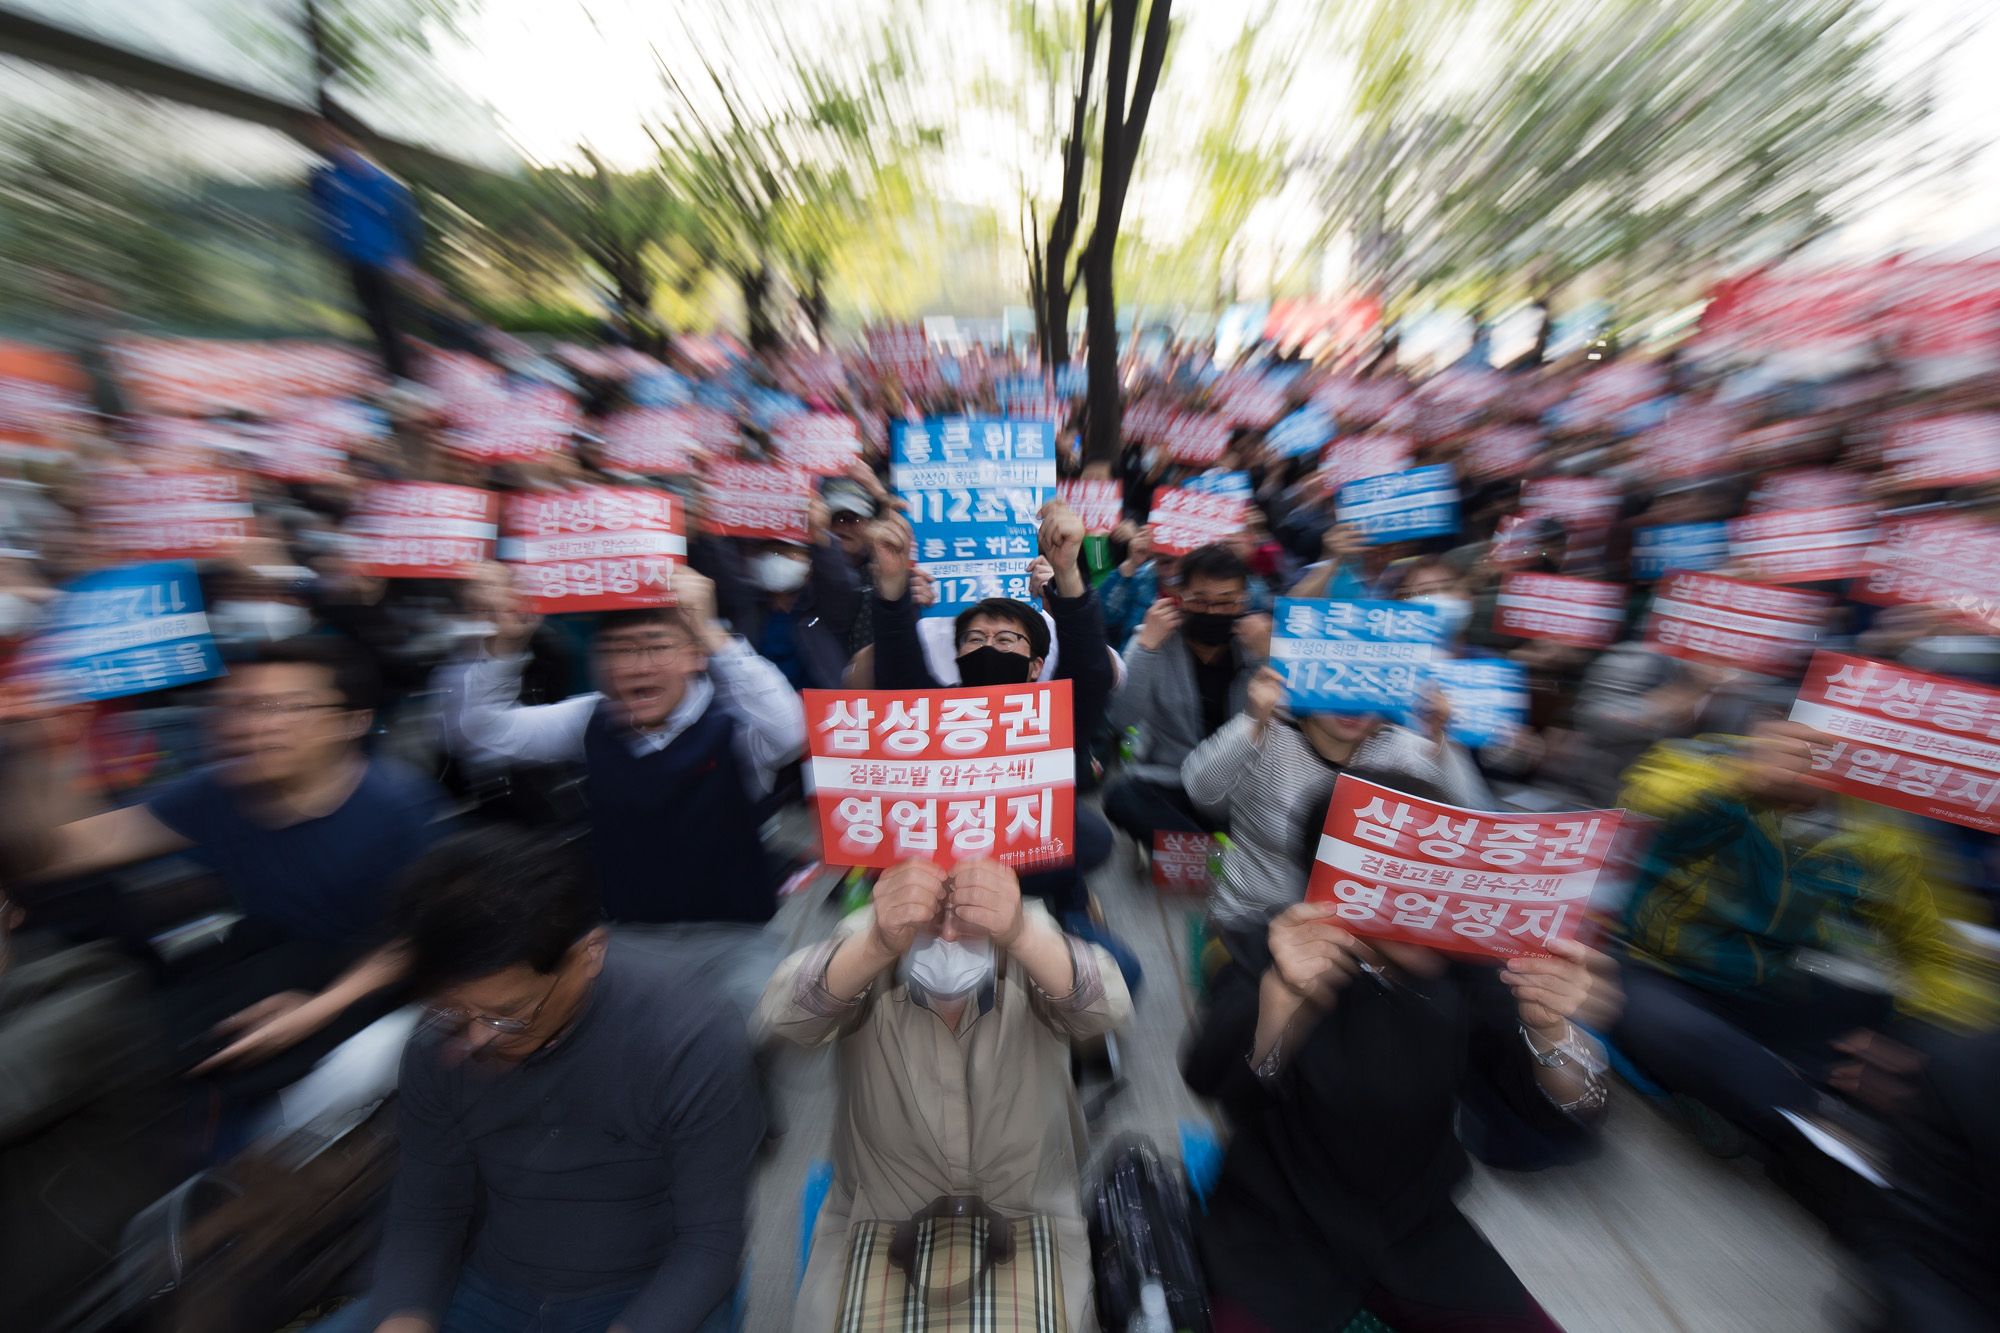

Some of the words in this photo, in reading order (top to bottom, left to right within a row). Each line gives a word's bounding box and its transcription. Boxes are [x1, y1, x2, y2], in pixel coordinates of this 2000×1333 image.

[984, 423, 1044, 461] 위조
[537, 557, 674, 597] 영업정지
[1285, 605, 1313, 633] 통
[1325, 602, 1353, 636] 큰
[1364, 607, 1425, 638] 위조
[1289, 641, 1327, 656] 삼성이
[1332, 643, 1358, 657] 하면
[1285, 661, 1416, 697] 112조원
[823, 690, 1051, 752] 삼성증권
[1824, 664, 2000, 740] 삼성증
[850, 764, 931, 786] 검찰고발
[939, 758, 1034, 786] 압수수색!
[838, 787, 1053, 850] 영업정지
[1353, 796, 1601, 866] 삼성증권
[1359, 853, 1454, 886] 검찰고발
[1460, 873, 1562, 897] 압수수색!
[1333, 879, 1568, 948] 영업정지
